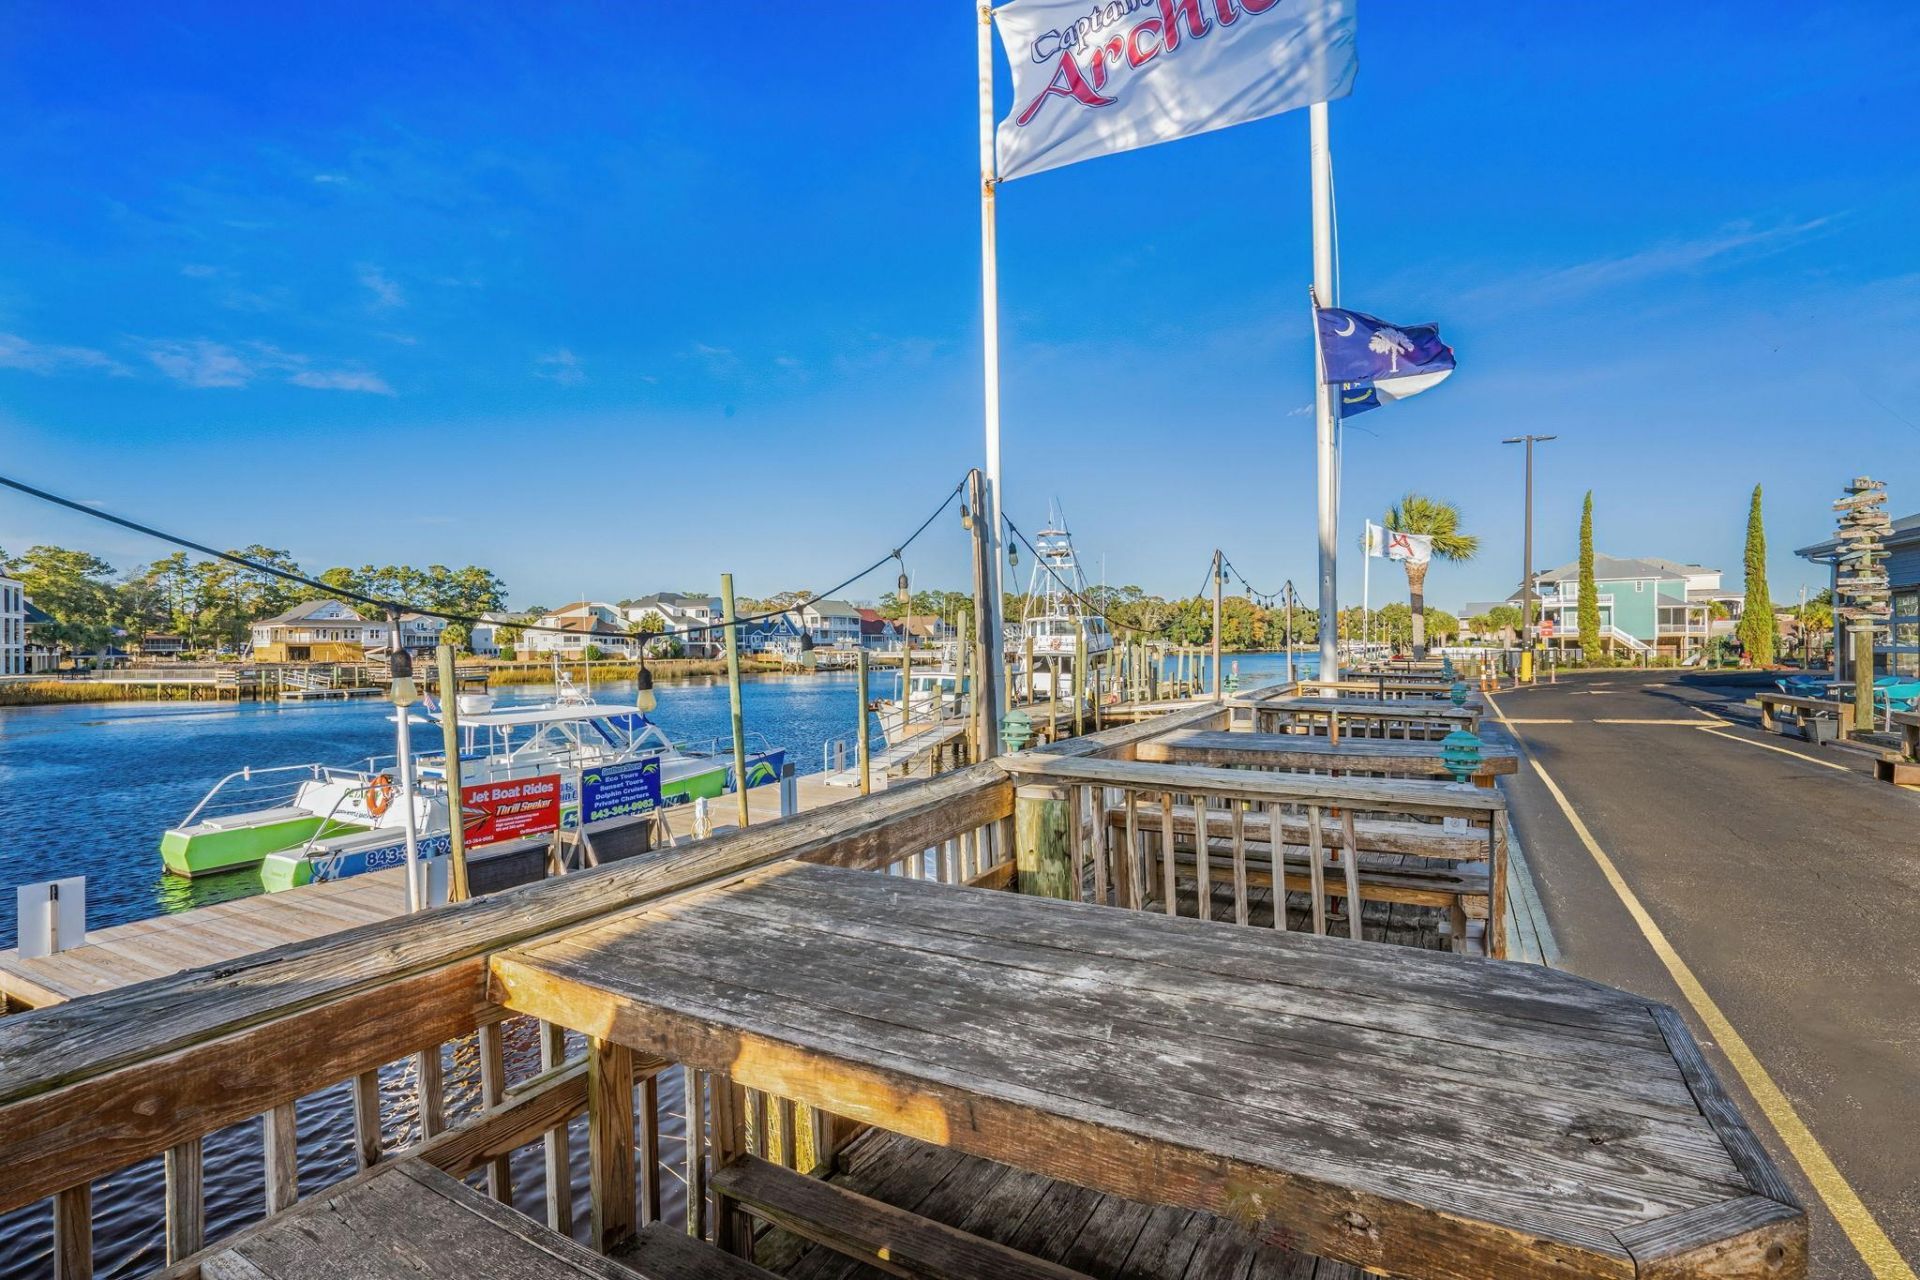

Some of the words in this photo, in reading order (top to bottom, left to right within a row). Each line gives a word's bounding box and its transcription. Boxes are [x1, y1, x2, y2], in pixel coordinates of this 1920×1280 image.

[1016, 0, 1279, 126] Arch
[600, 782, 624, 792] Sunset
[625, 778, 644, 786] Tours
[605, 775, 618, 783] Eco
[620, 772, 639, 780] Tours
[468, 791, 490, 804] Jet
[492, 786, 520, 801] Boat
[522, 782, 554, 796] Rides
[594, 798, 619, 808] Private
[620, 792, 650, 802] Charters
[595, 790, 622, 800] Dolphin
[623, 785, 648, 794] Cruises
[496, 802, 521, 816] Thrill
[520, 799, 553, 812] Seeker
